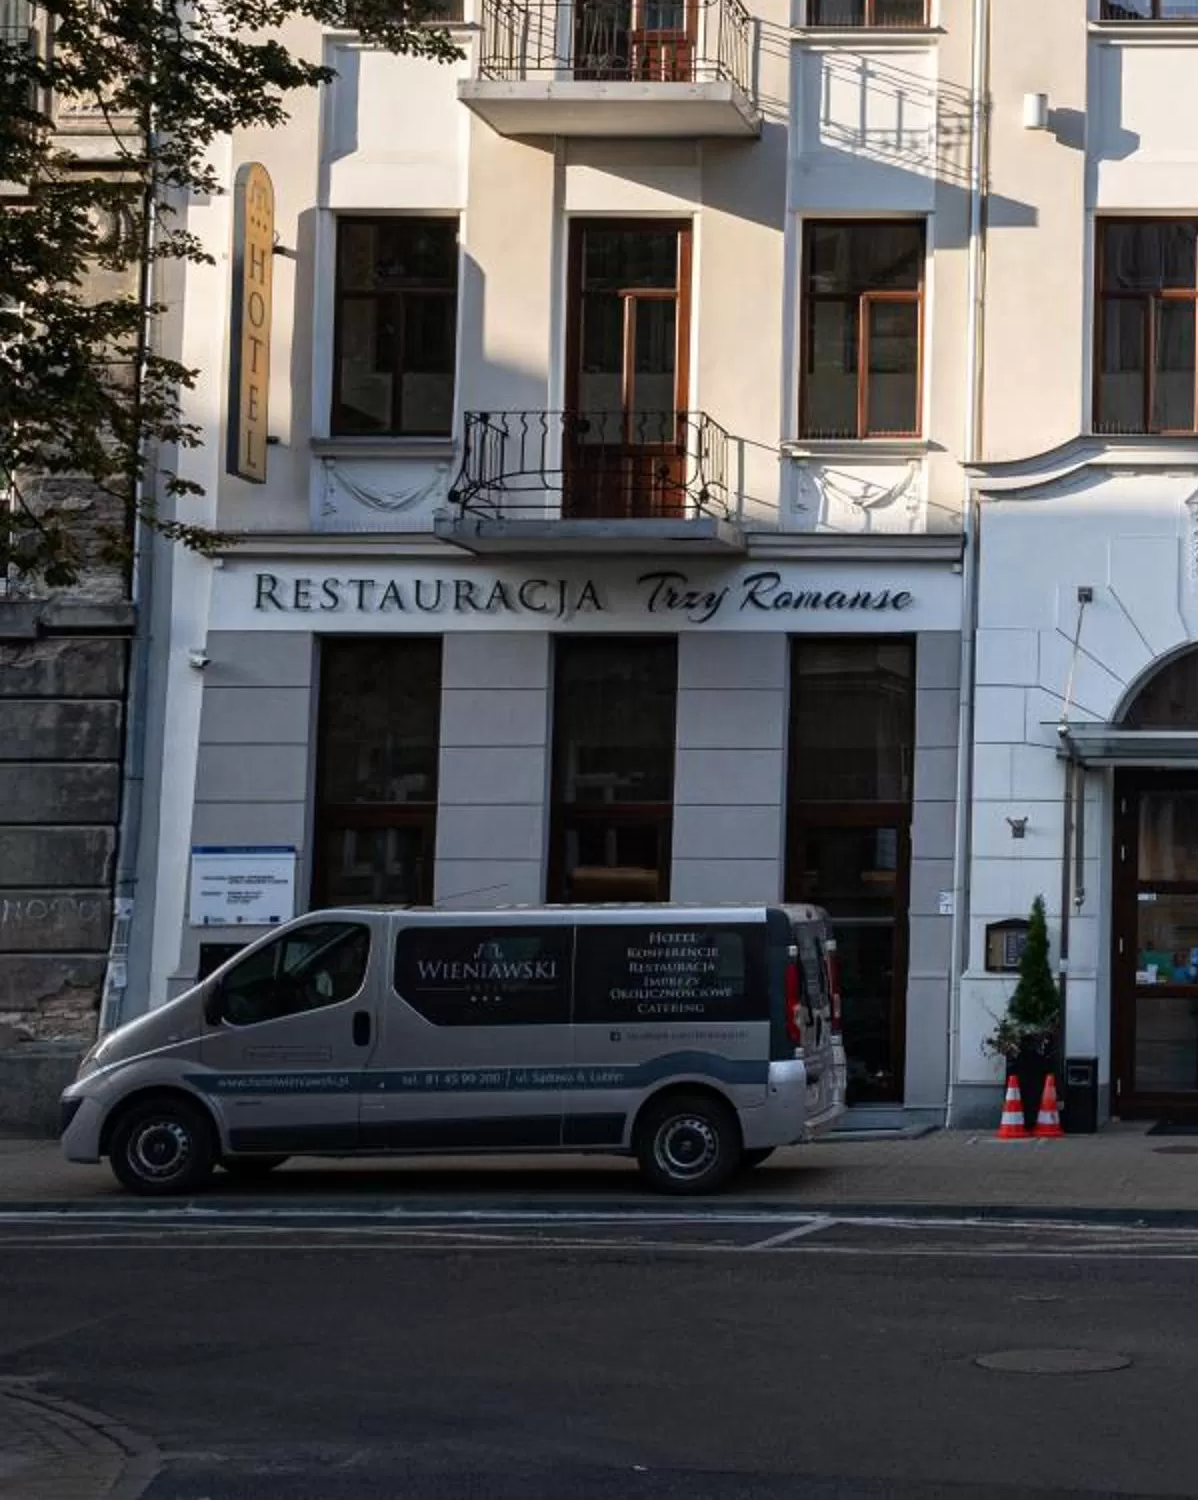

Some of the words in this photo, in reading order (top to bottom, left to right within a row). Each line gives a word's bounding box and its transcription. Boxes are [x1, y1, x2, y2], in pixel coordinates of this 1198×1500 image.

[246, 243, 265, 469] HOTEL
[255, 573, 605, 618] RESTAURACJA
[637, 571, 729, 623] Trzy
[740, 571, 914, 612] Romanse
[649, 932, 697, 944] HOTEL
[418, 960, 556, 980] WIENIAWSKI
[637, 1003, 705, 1014] CATERING
